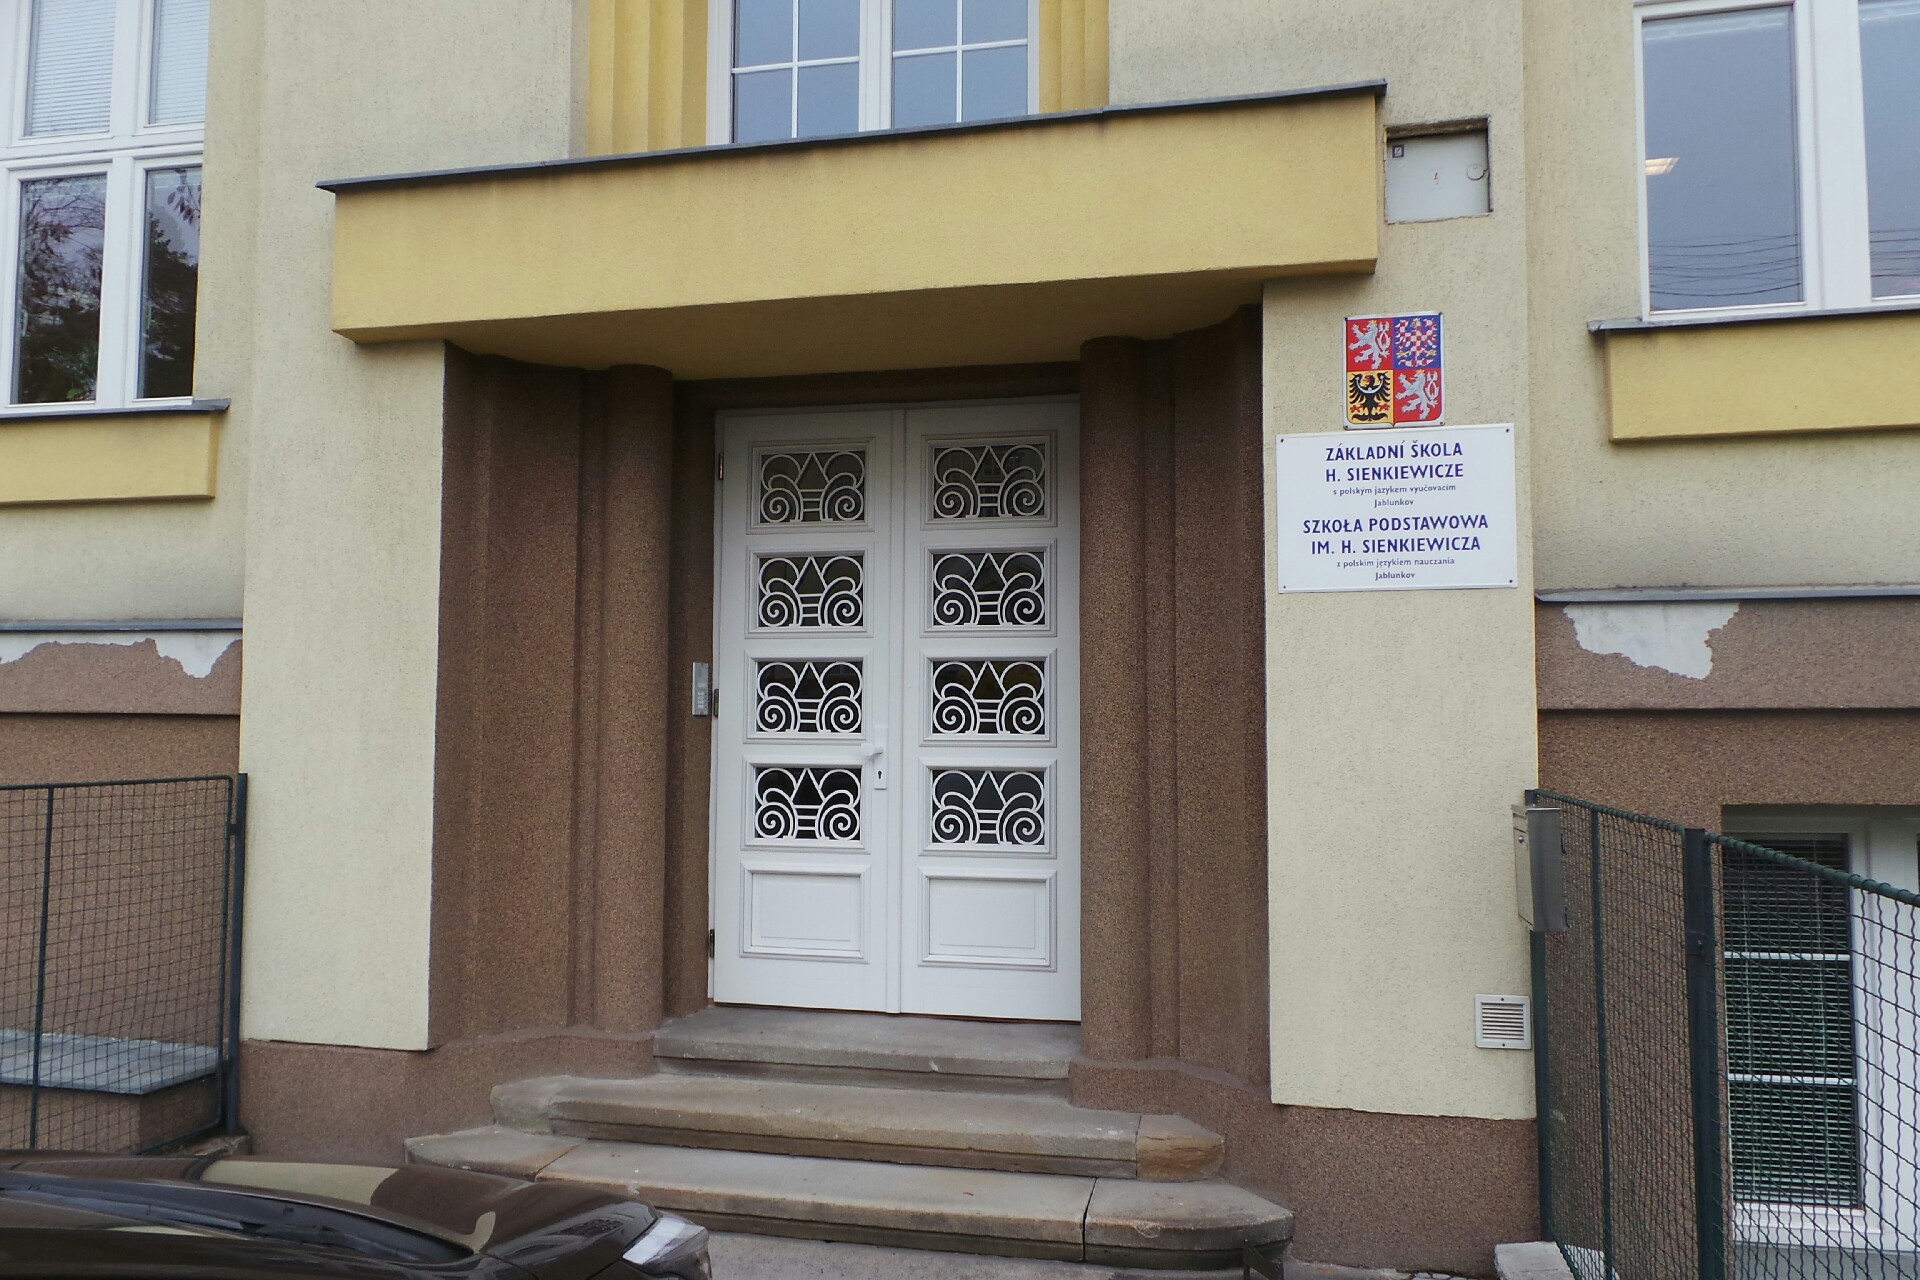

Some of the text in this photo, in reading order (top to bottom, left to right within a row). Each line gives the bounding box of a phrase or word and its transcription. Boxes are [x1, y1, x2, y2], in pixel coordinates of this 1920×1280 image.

[1325, 439, 1463, 462] ZÁKLADNÍ ŠKOLA
[1325, 463, 1464, 482] H. SIENKIEWICZE
[1339, 487, 1373, 497] polským
[1374, 485, 1407, 496] jazykem
[1374, 498, 1414, 508] Jablunkov
[1303, 514, 1488, 534] SZKOŁA PODSTAWOWA
[1311, 536, 1481, 555] IM. H. SIENKIEWICZA
[1343, 559, 1374, 569] polskim
[1376, 558, 1412, 568] językiem
[1414, 556, 1455, 566] nauczania
[1375, 571, 1416, 581] Jablunkov
